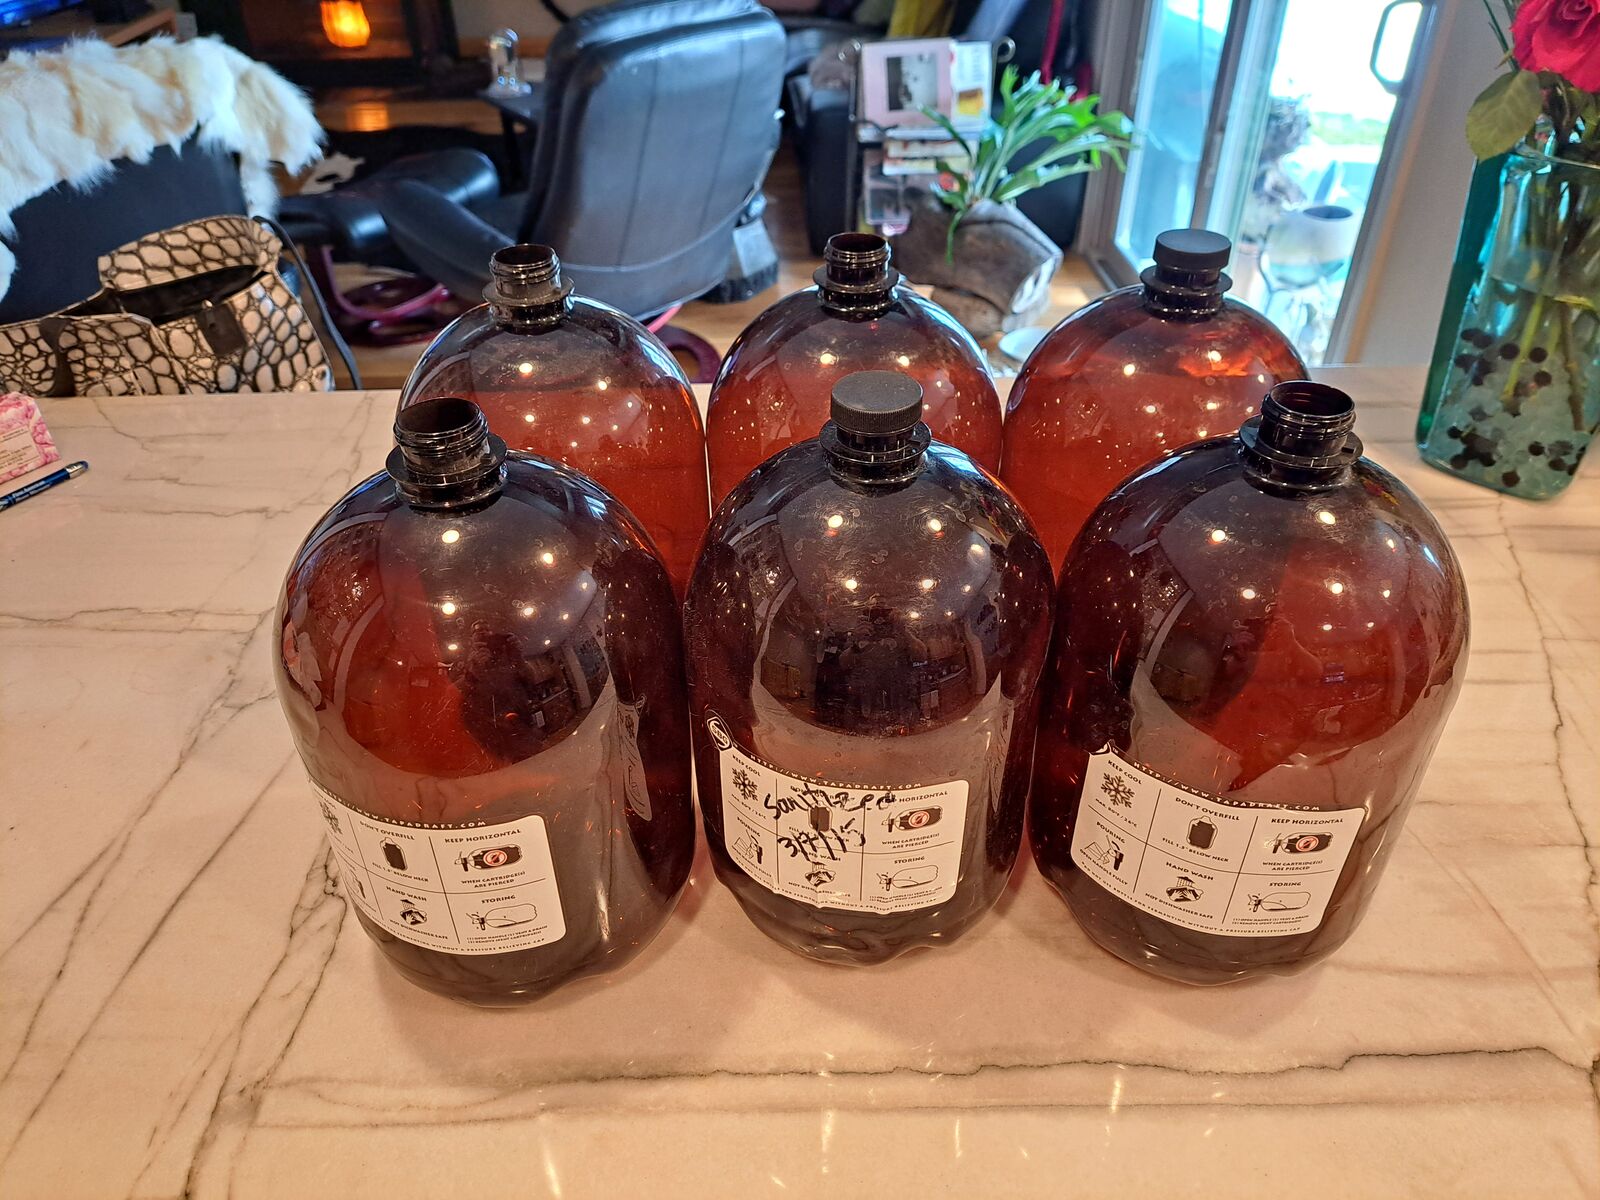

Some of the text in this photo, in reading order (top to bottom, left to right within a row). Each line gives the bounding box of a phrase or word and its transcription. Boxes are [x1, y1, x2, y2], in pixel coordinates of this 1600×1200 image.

[745, 764, 761, 777] COOL
[750, 755, 922, 790] HTTP://WWW.TAPADRAFT.COM
[1107, 759, 1142, 784] KEEP COOL
[1133, 762, 1320, 811] HTTP://WWW.TAPADRAFT.COM
[899, 790, 948, 803] HORIZONTAL
[1175, 797, 1240, 821] DON'T OVERFILL
[380, 829, 416, 841] OVERFILL
[466, 828, 522, 843] HORIZONTAL
[1096, 821, 1126, 844] POURING
[905, 839, 929, 848] PIERCED
[1162, 837, 1174, 846] FILL
[1188, 848, 1211, 858] BELOW
[894, 856, 925, 864] STORING
[1165, 861, 1214, 881] HAND WASH
[488, 879, 515, 888] PIERCED
[1112, 874, 1128, 886] FULLY
[386, 886, 406, 896] HAND
[481, 894, 516, 904] STORING
[1145, 892, 1157, 901] NOT
[1158, 899, 1199, 916] DISHWASHER
[1188, 921, 1218, 931] WITHOUT
